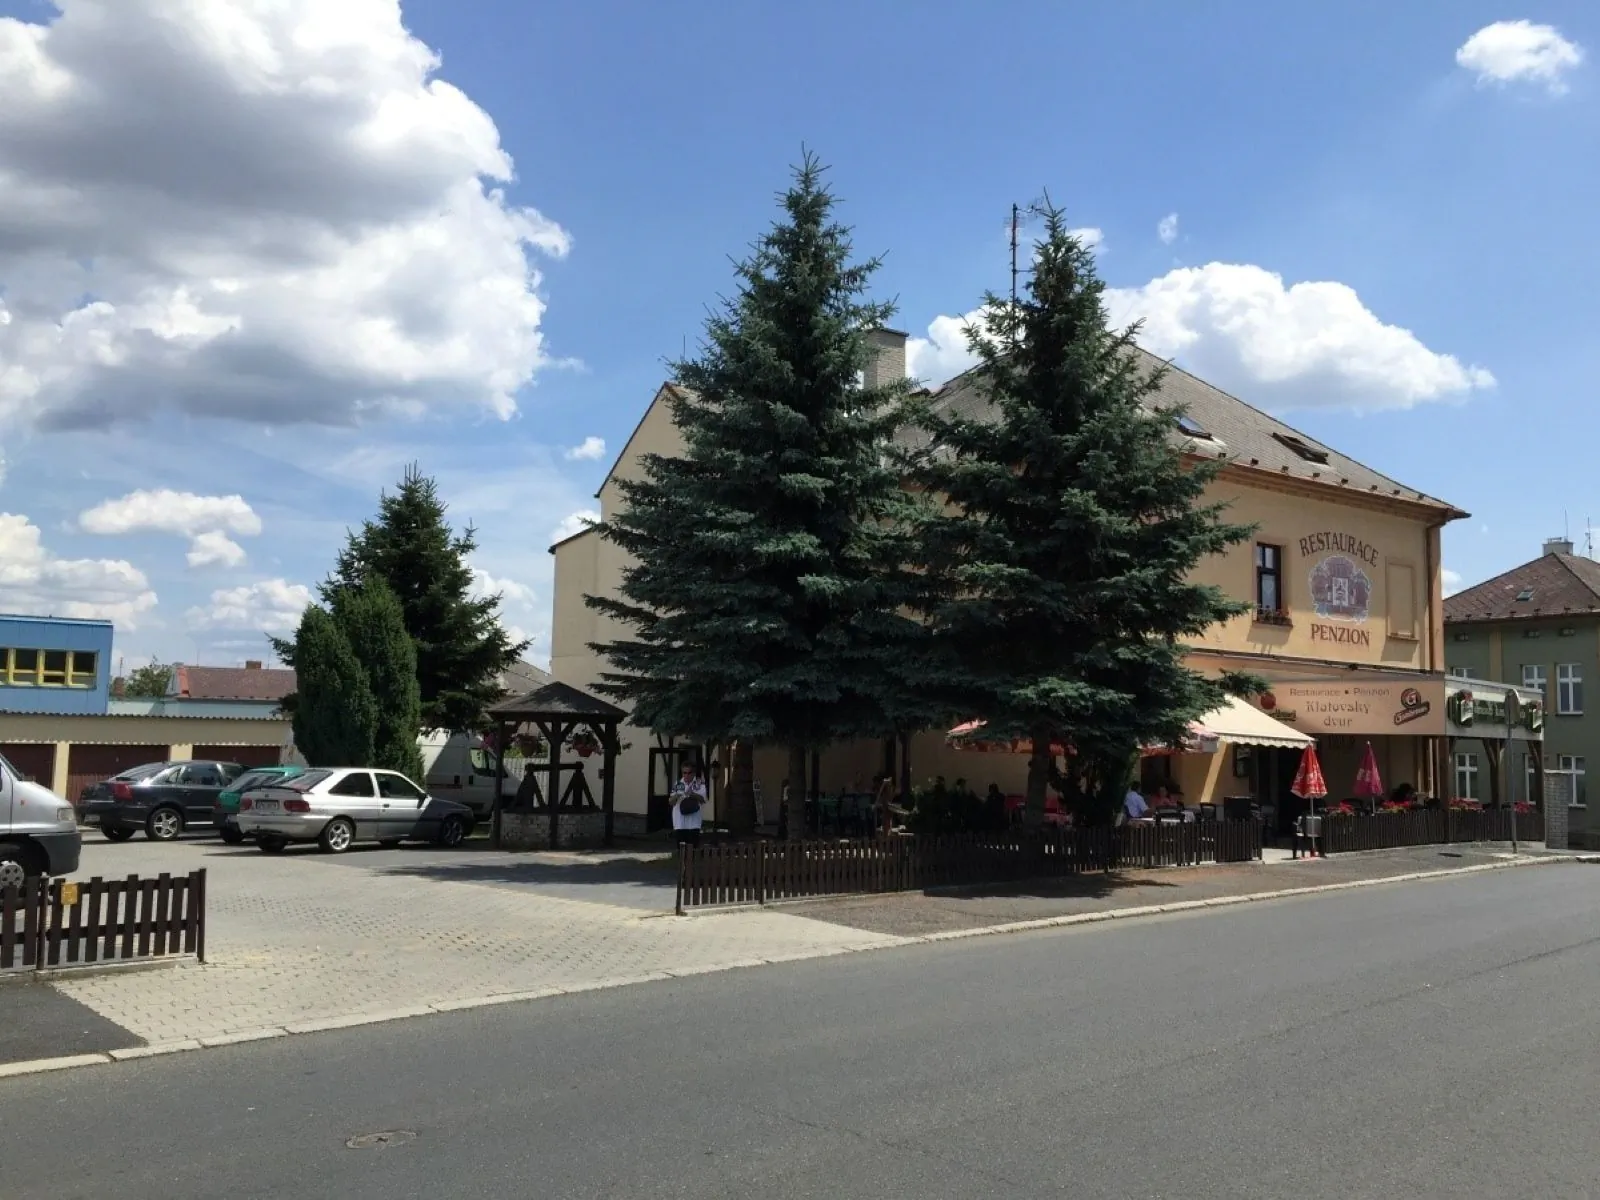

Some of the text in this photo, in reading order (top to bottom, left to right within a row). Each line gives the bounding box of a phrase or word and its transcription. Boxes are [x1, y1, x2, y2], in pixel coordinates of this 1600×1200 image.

[1299, 531, 1379, 567] RESTAURACE
[1310, 623, 1370, 647] PENZION
[1290, 687, 1390, 697] Restaurace Penzion
